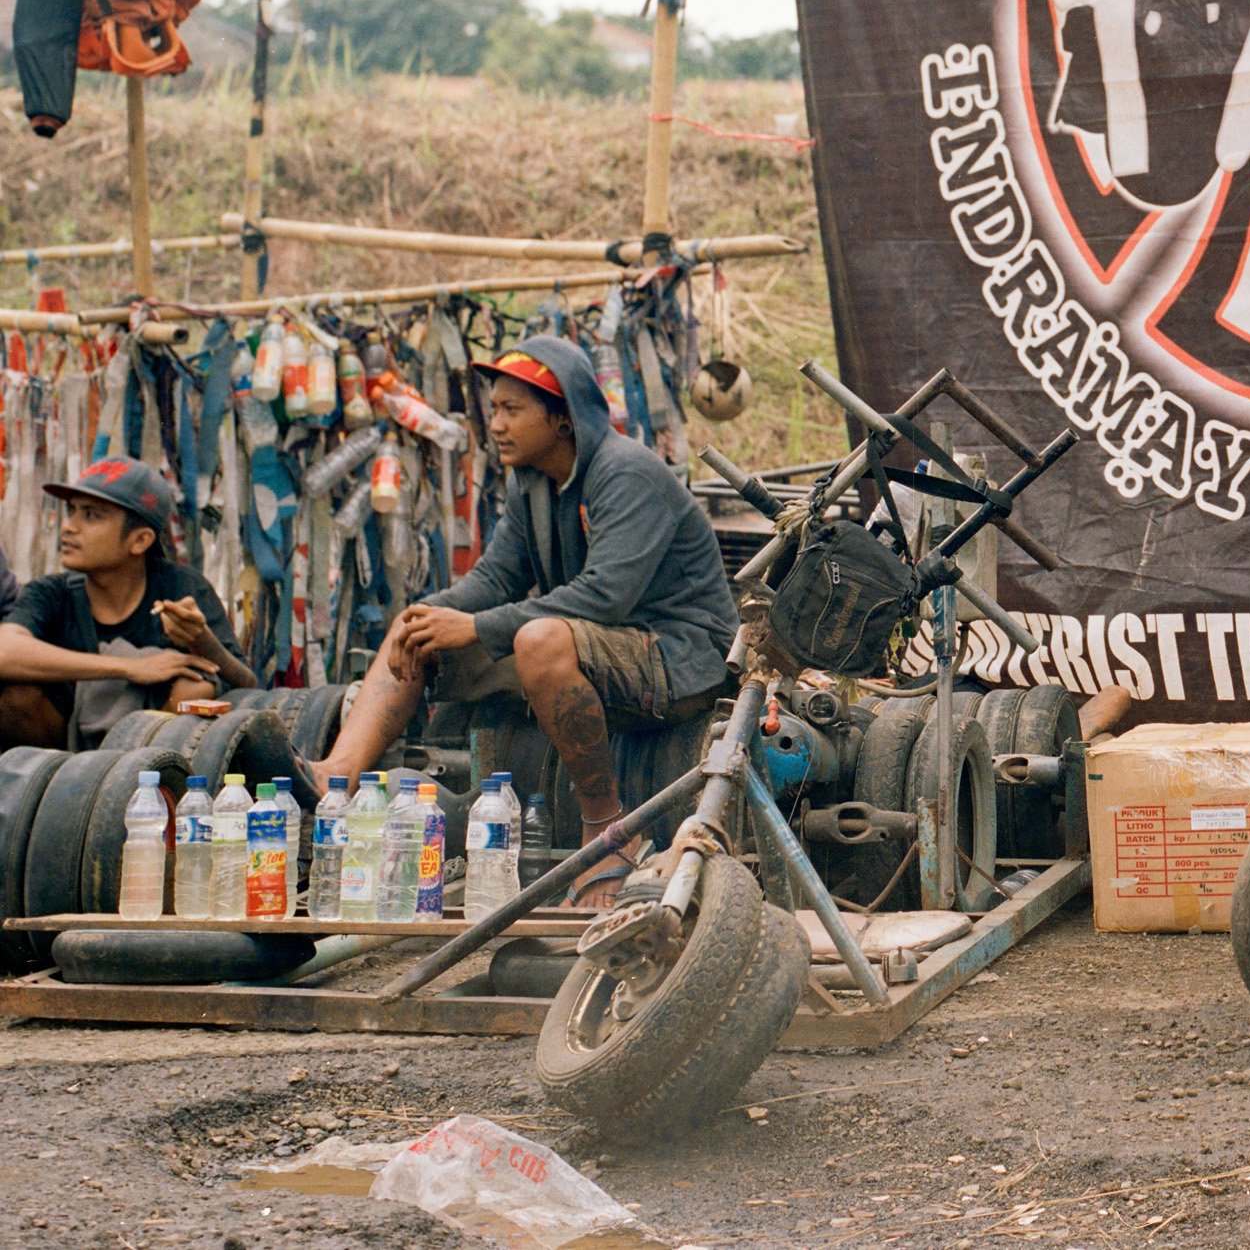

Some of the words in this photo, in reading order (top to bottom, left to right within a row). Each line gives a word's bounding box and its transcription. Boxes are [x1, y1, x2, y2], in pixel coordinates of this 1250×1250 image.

[1126, 822, 1154, 830] LITHO
[1125, 835, 1156, 843] BATCH
[1194, 860, 1210, 868] pcs
